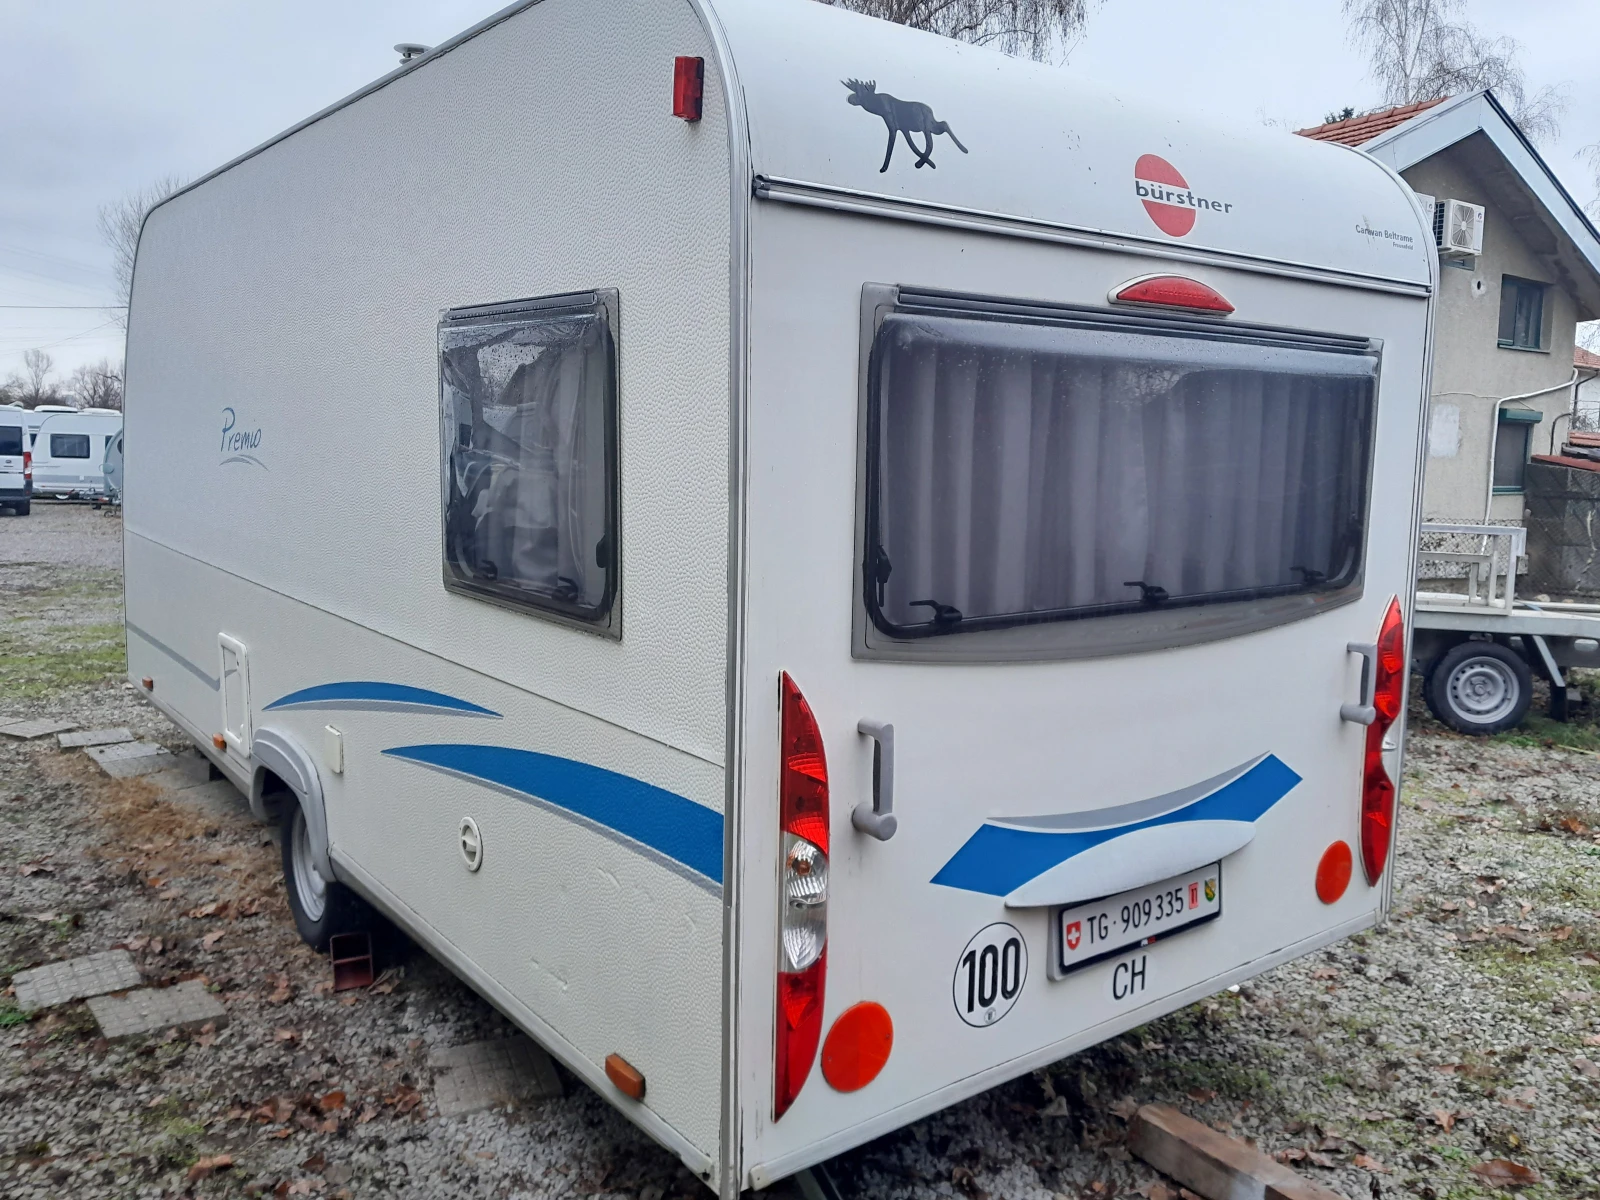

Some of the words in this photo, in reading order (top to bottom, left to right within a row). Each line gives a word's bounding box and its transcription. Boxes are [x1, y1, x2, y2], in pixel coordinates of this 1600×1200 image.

[1135, 180, 1233, 214] bürstner
[1384, 229, 1414, 243] Beltrame
[220, 407, 262, 452] Premio
[962, 937, 1021, 1014] 100
[1112, 955, 1147, 1001] CH
